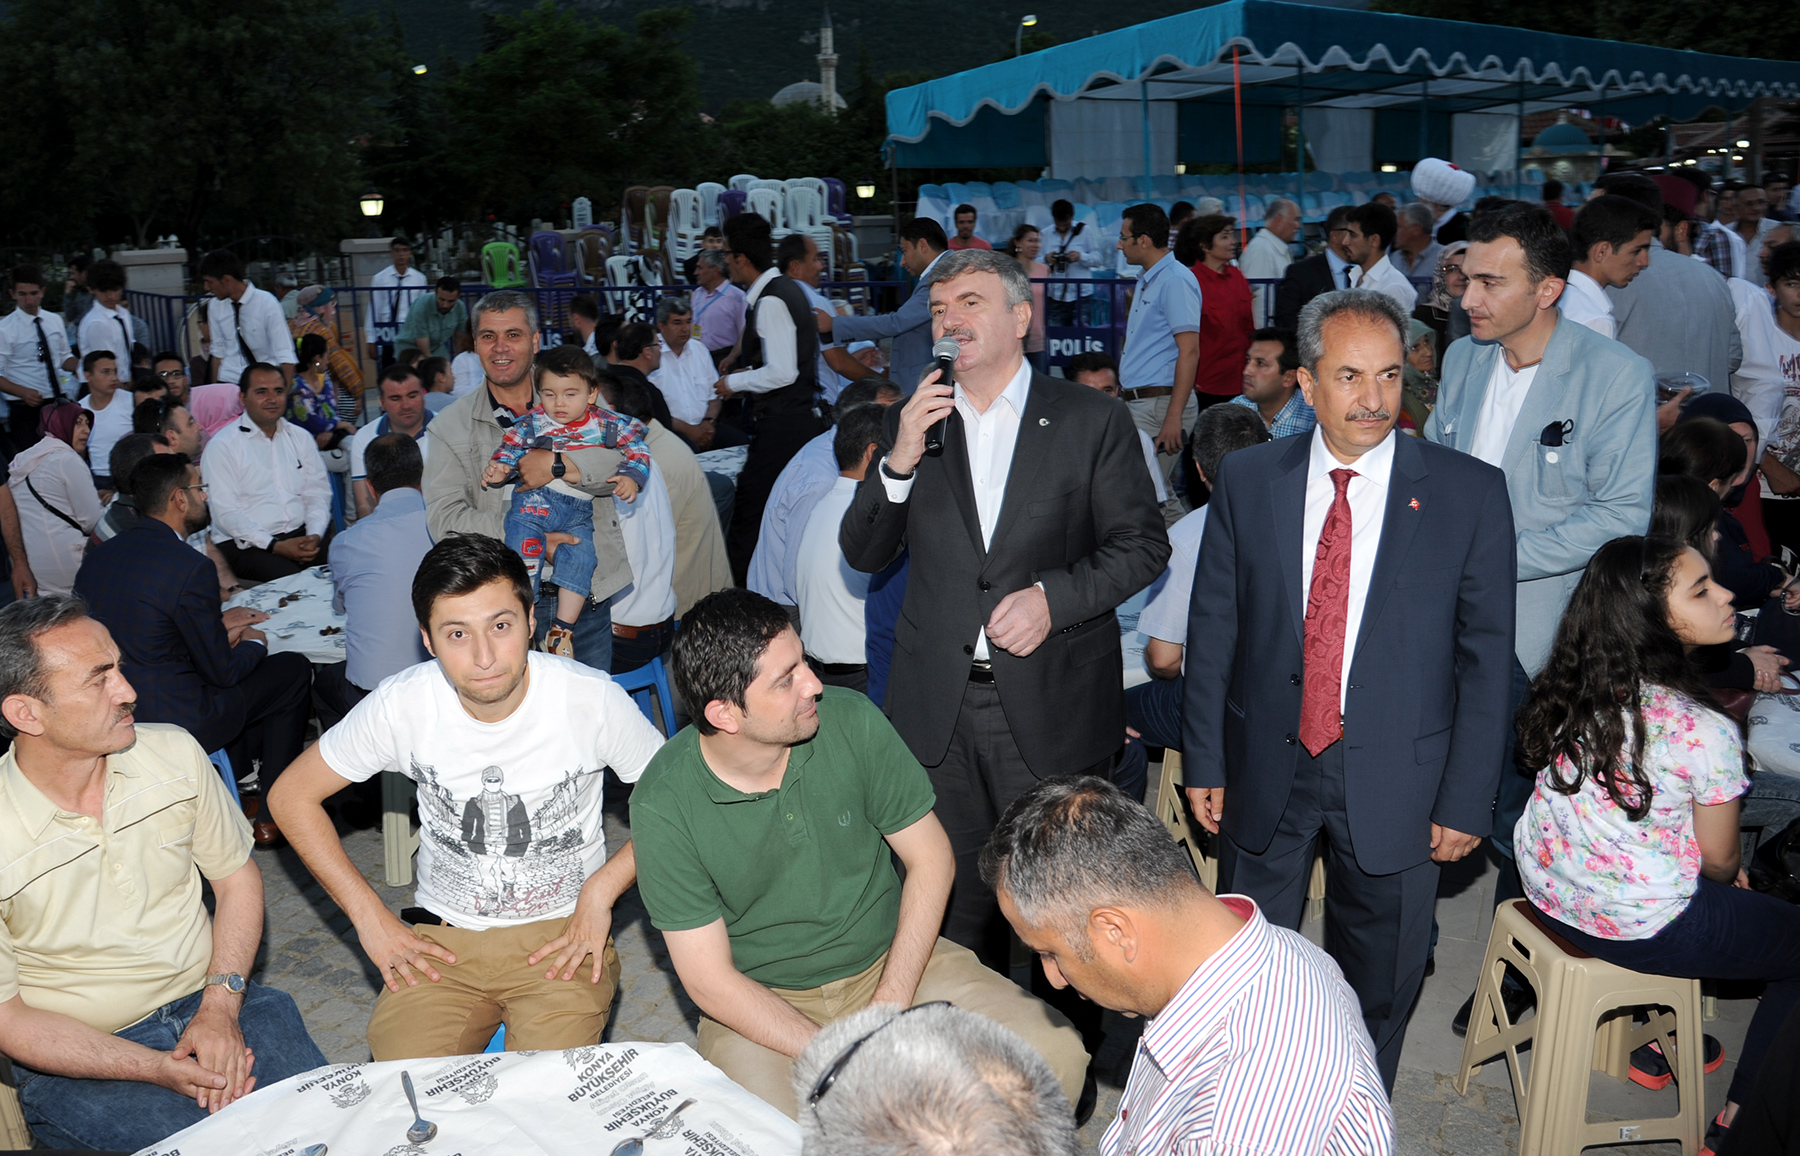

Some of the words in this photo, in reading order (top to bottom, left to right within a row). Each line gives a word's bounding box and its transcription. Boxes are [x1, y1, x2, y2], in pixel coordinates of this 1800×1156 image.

[1050, 336, 1104, 357] POLİS
[321, 1069, 362, 1092] KONYA
[567, 1047, 640, 1103] BÜYÜKŞEHİR
[577, 1051, 614, 1083] KONYA
[589, 1066, 634, 1100] BELEDİYESİ
[612, 1090, 656, 1119] BELEDİYESİ
[631, 1104, 669, 1128] KONYA
